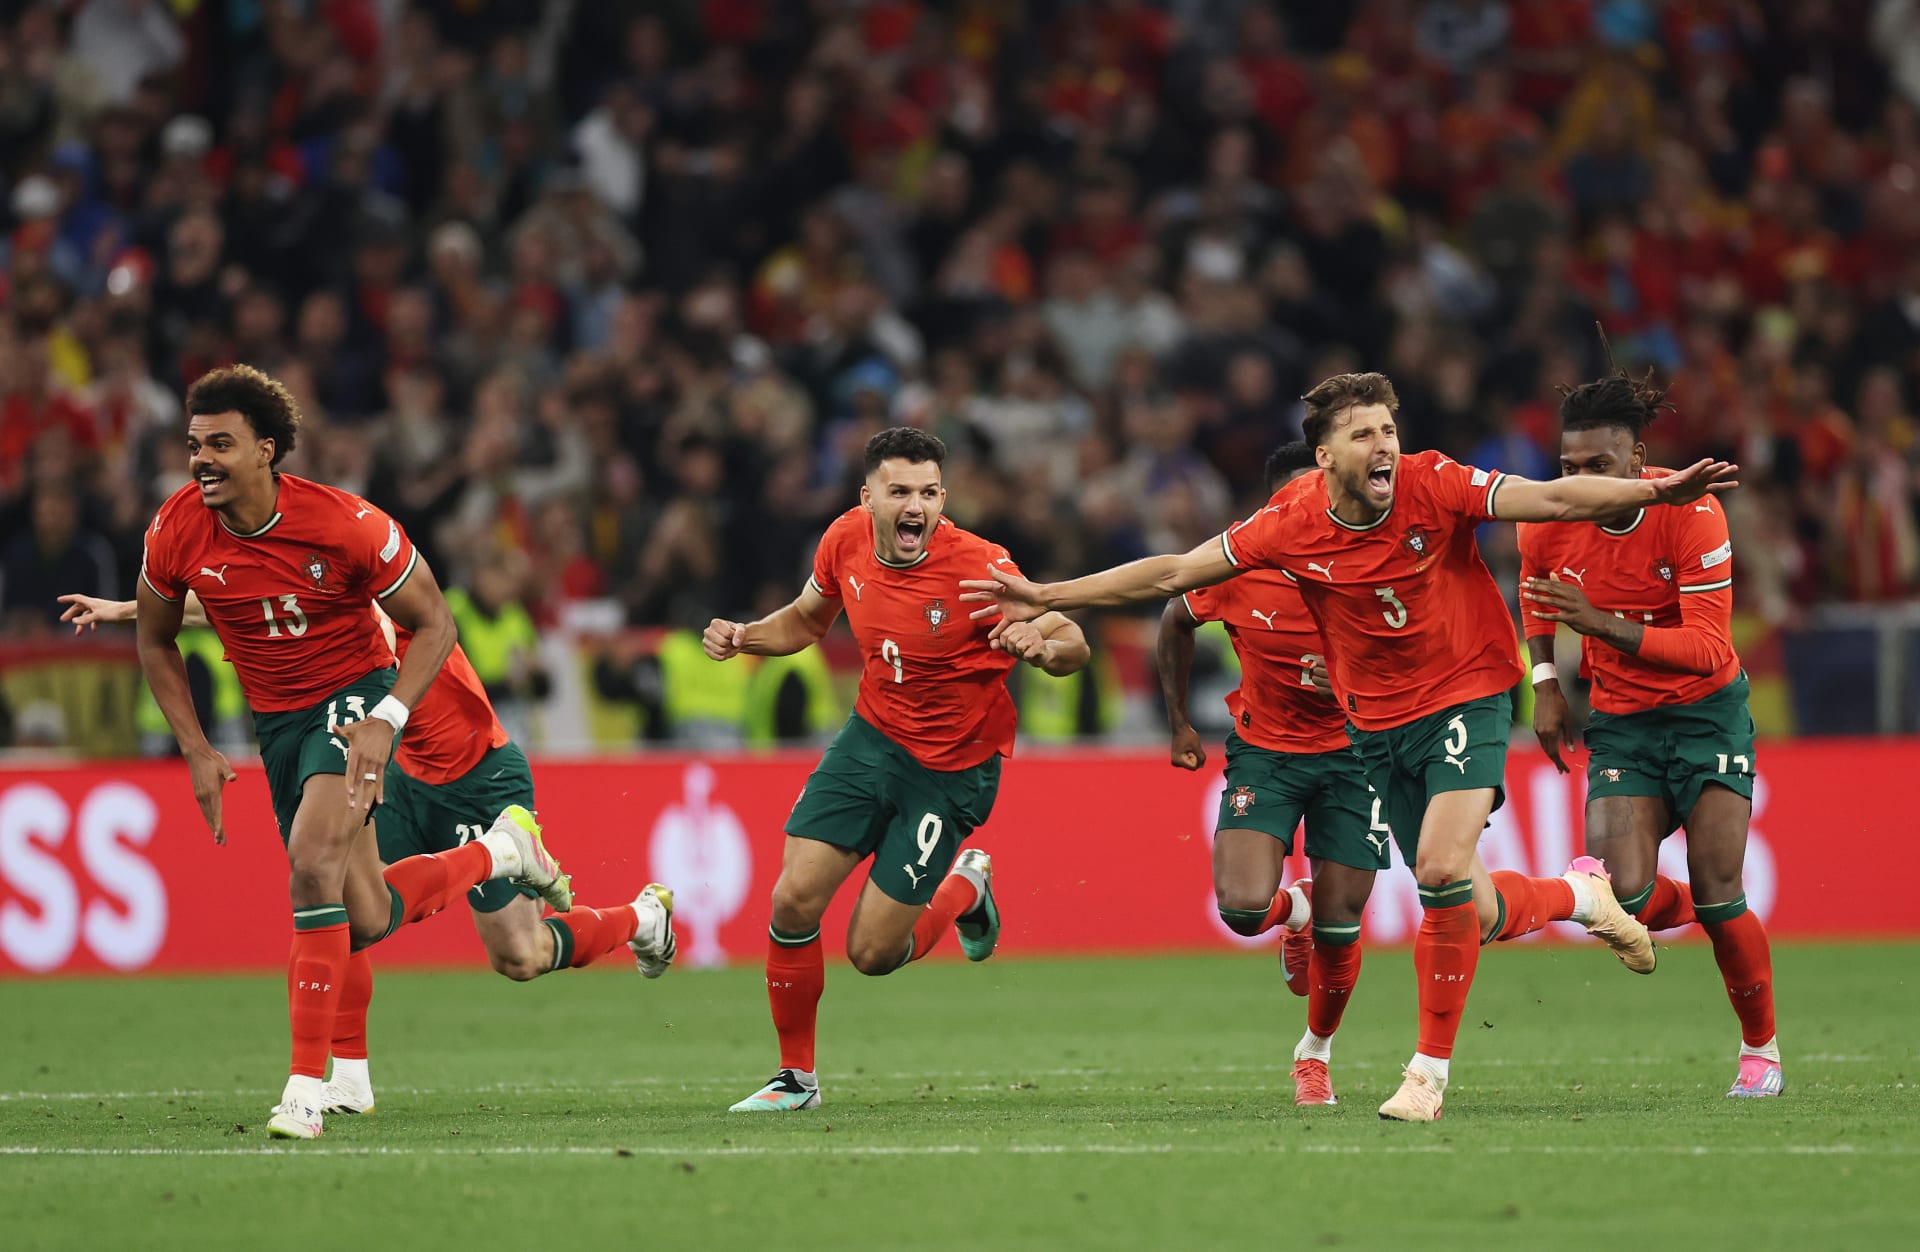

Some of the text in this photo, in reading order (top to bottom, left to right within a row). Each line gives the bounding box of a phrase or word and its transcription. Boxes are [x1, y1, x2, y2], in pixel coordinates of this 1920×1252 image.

[258, 594, 308, 637] 13
[1375, 586, 1407, 628] 3
[882, 638, 903, 684] 9
[1444, 714, 1468, 756] 3
[917, 812, 943, 868] 9
[0, 780, 170, 973] SS
